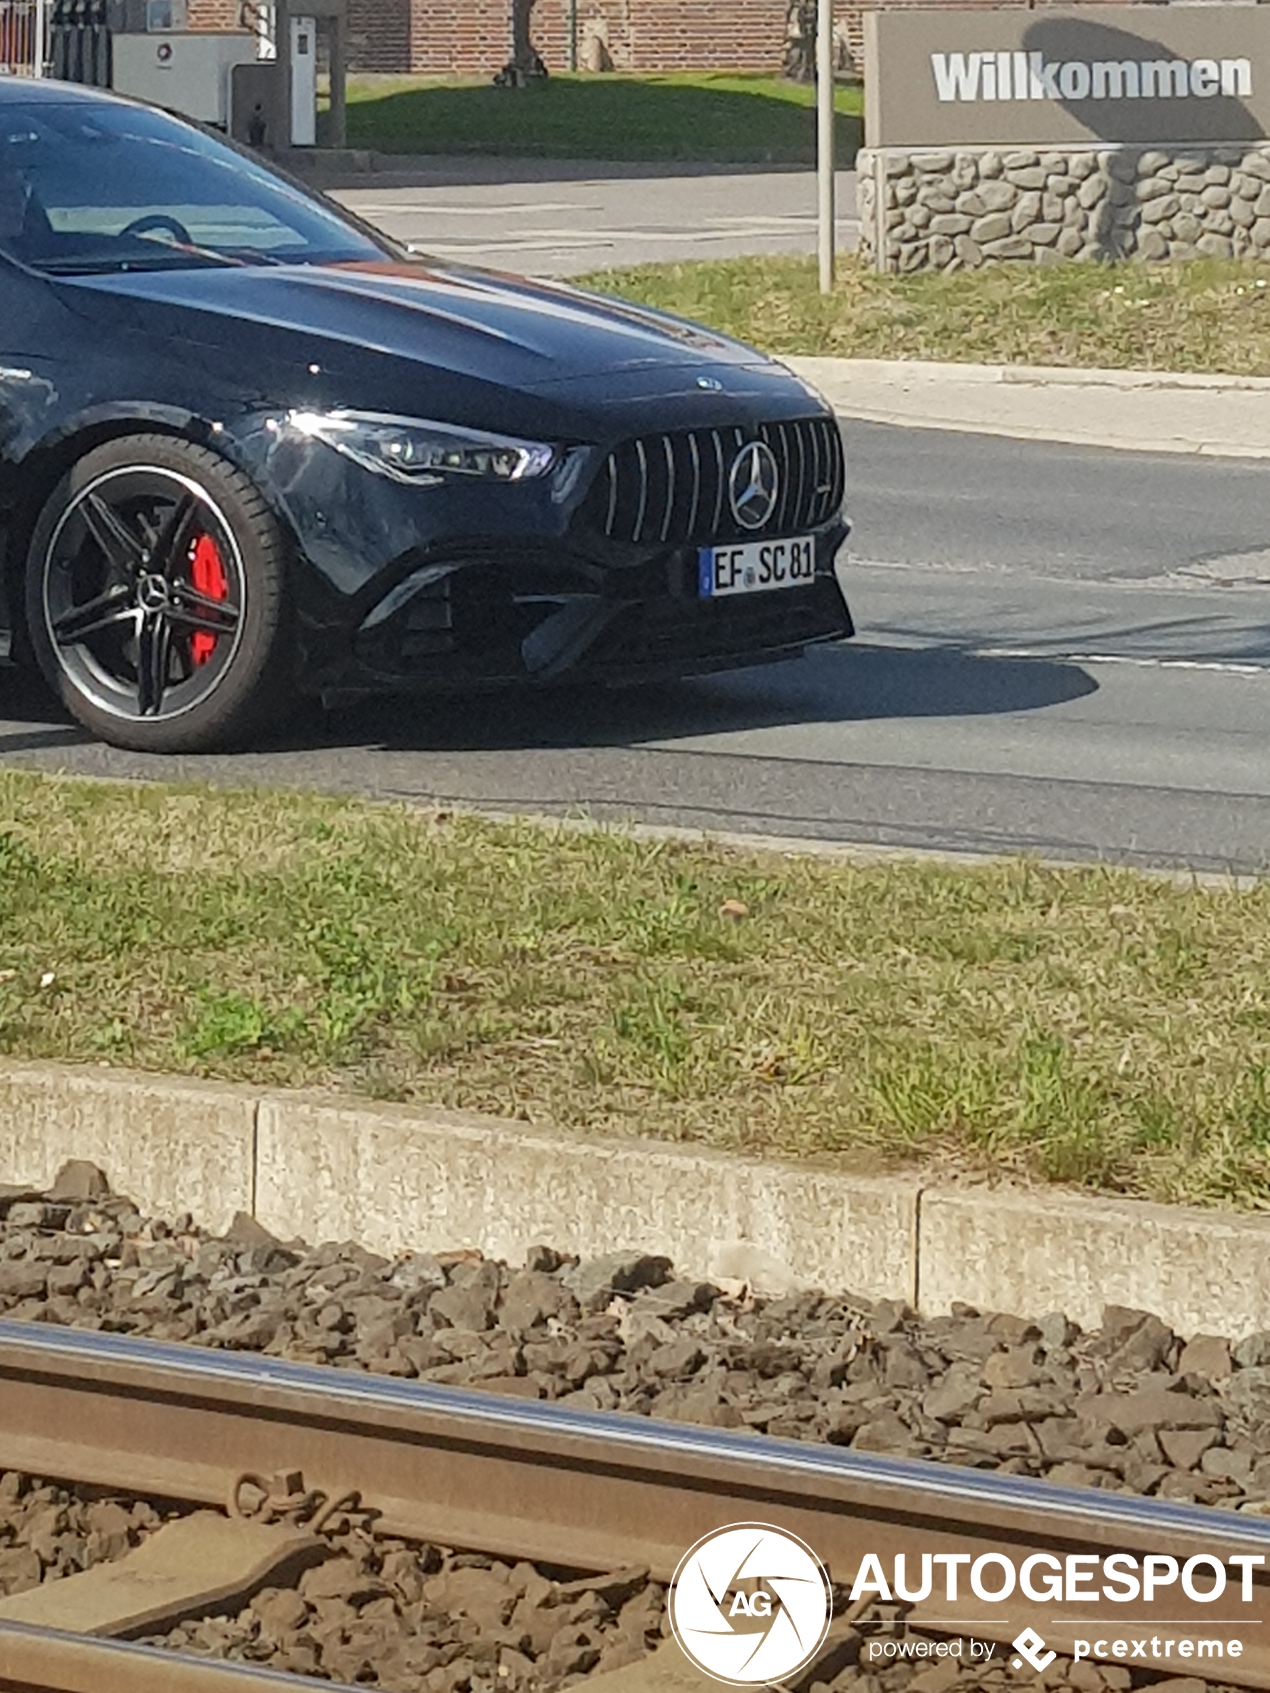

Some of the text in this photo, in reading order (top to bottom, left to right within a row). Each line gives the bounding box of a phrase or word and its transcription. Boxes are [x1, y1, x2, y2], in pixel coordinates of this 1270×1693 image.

[930, 51, 1253, 102] Willkommen
[714, 541, 812, 589] EF SC 81
